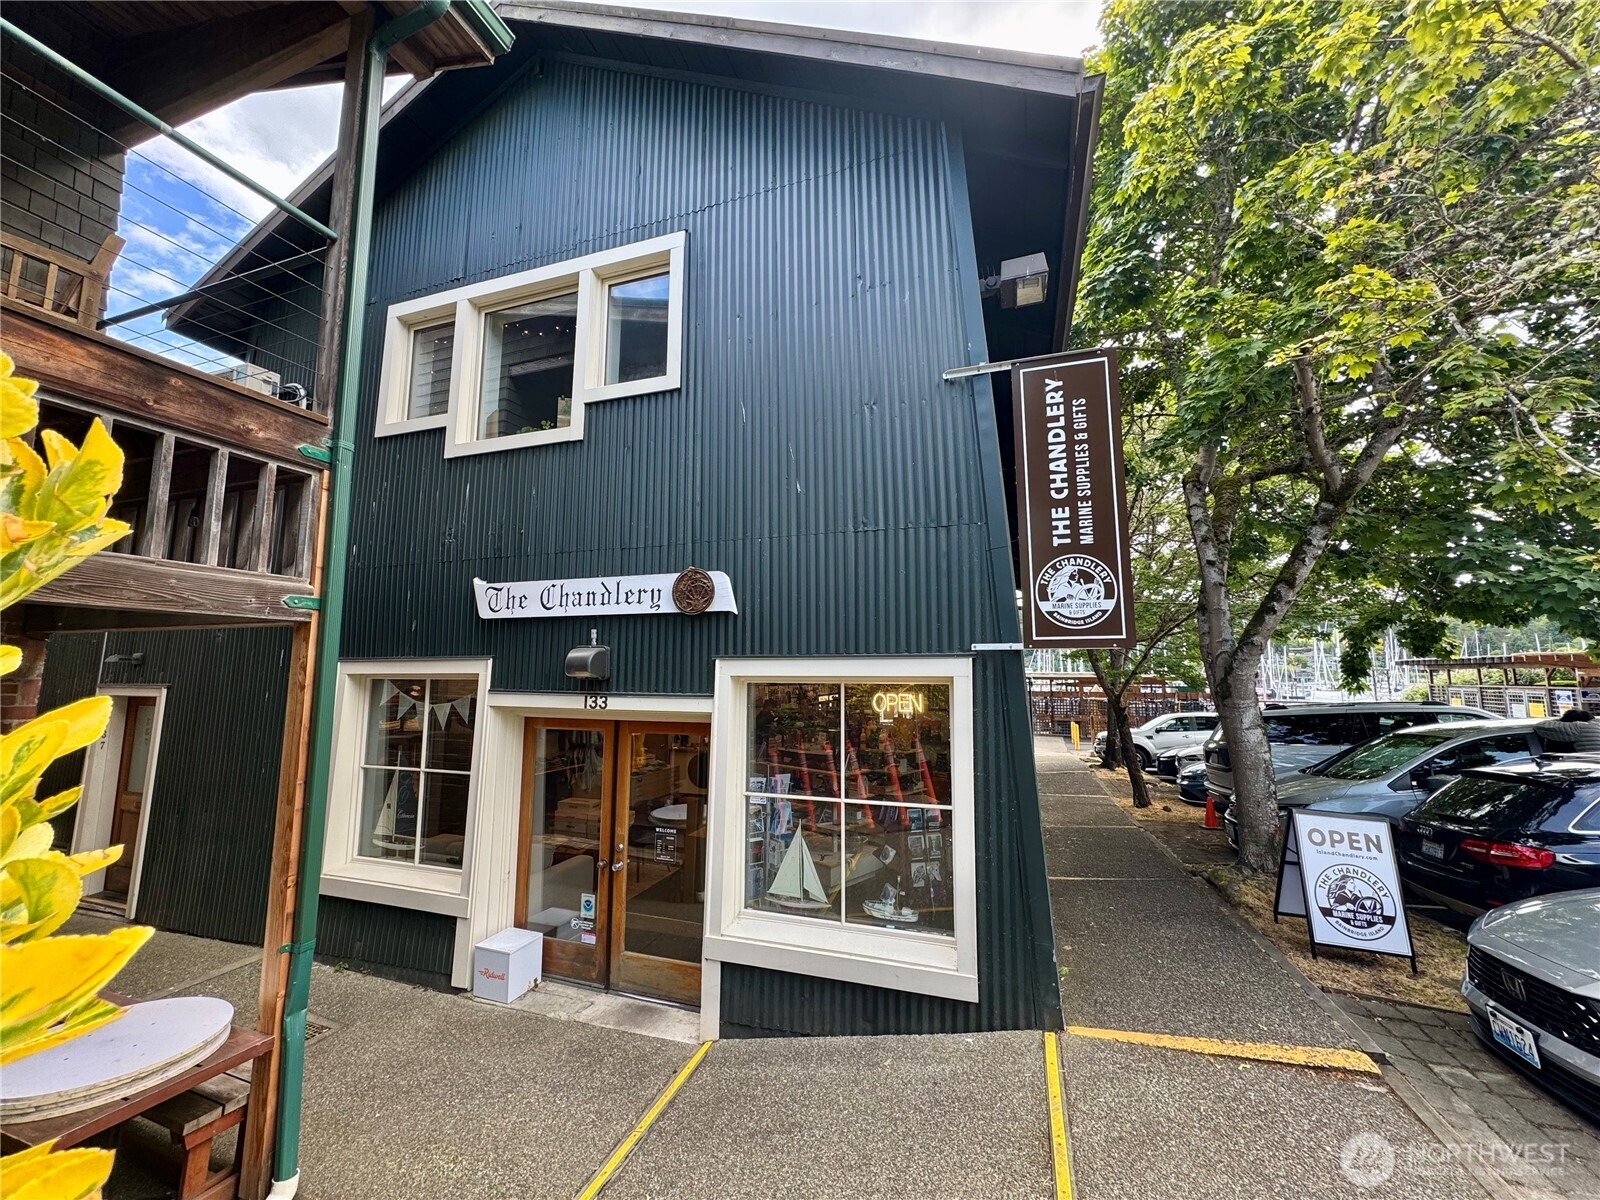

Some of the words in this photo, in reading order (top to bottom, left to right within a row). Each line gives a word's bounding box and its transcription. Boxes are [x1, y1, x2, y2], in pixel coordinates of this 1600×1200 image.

[1072, 398, 1087, 429] GIFTS
[1045, 378, 1069, 500] CHANDLERY
[1074, 432, 1088, 441] &
[1075, 443, 1091, 496] SUPPLIES
[1051, 506, 1072, 548] THE
[1077, 500, 1094, 545] MARINE
[1040, 568, 1056, 585] THE
[1056, 557, 1112, 583] CHANDLERY
[485, 585, 529, 615] The
[540, 580, 663, 614] Chandlery
[1075, 601, 1102, 609] SUPPLIES
[1053, 612, 1085, 625] BAINBRIDGE
[1085, 611, 1103, 624] ISLAND
[583, 695, 608, 710] 133
[872, 693, 922, 712] OPEN
[1307, 827, 1383, 854] OPEN
[1316, 849, 1378, 860] IslandChandlery.com
[1319, 873, 1333, 890] THE
[1332, 867, 1389, 899] CHANDLERY
[1332, 910, 1355, 919] MARINE
[1356, 912, 1383, 923] SUPPLIES
[1335, 920, 1367, 937] BAINBRIDGE
[1368, 926, 1385, 937] ISLAND
[480, 967, 505, 981] Ridwell
